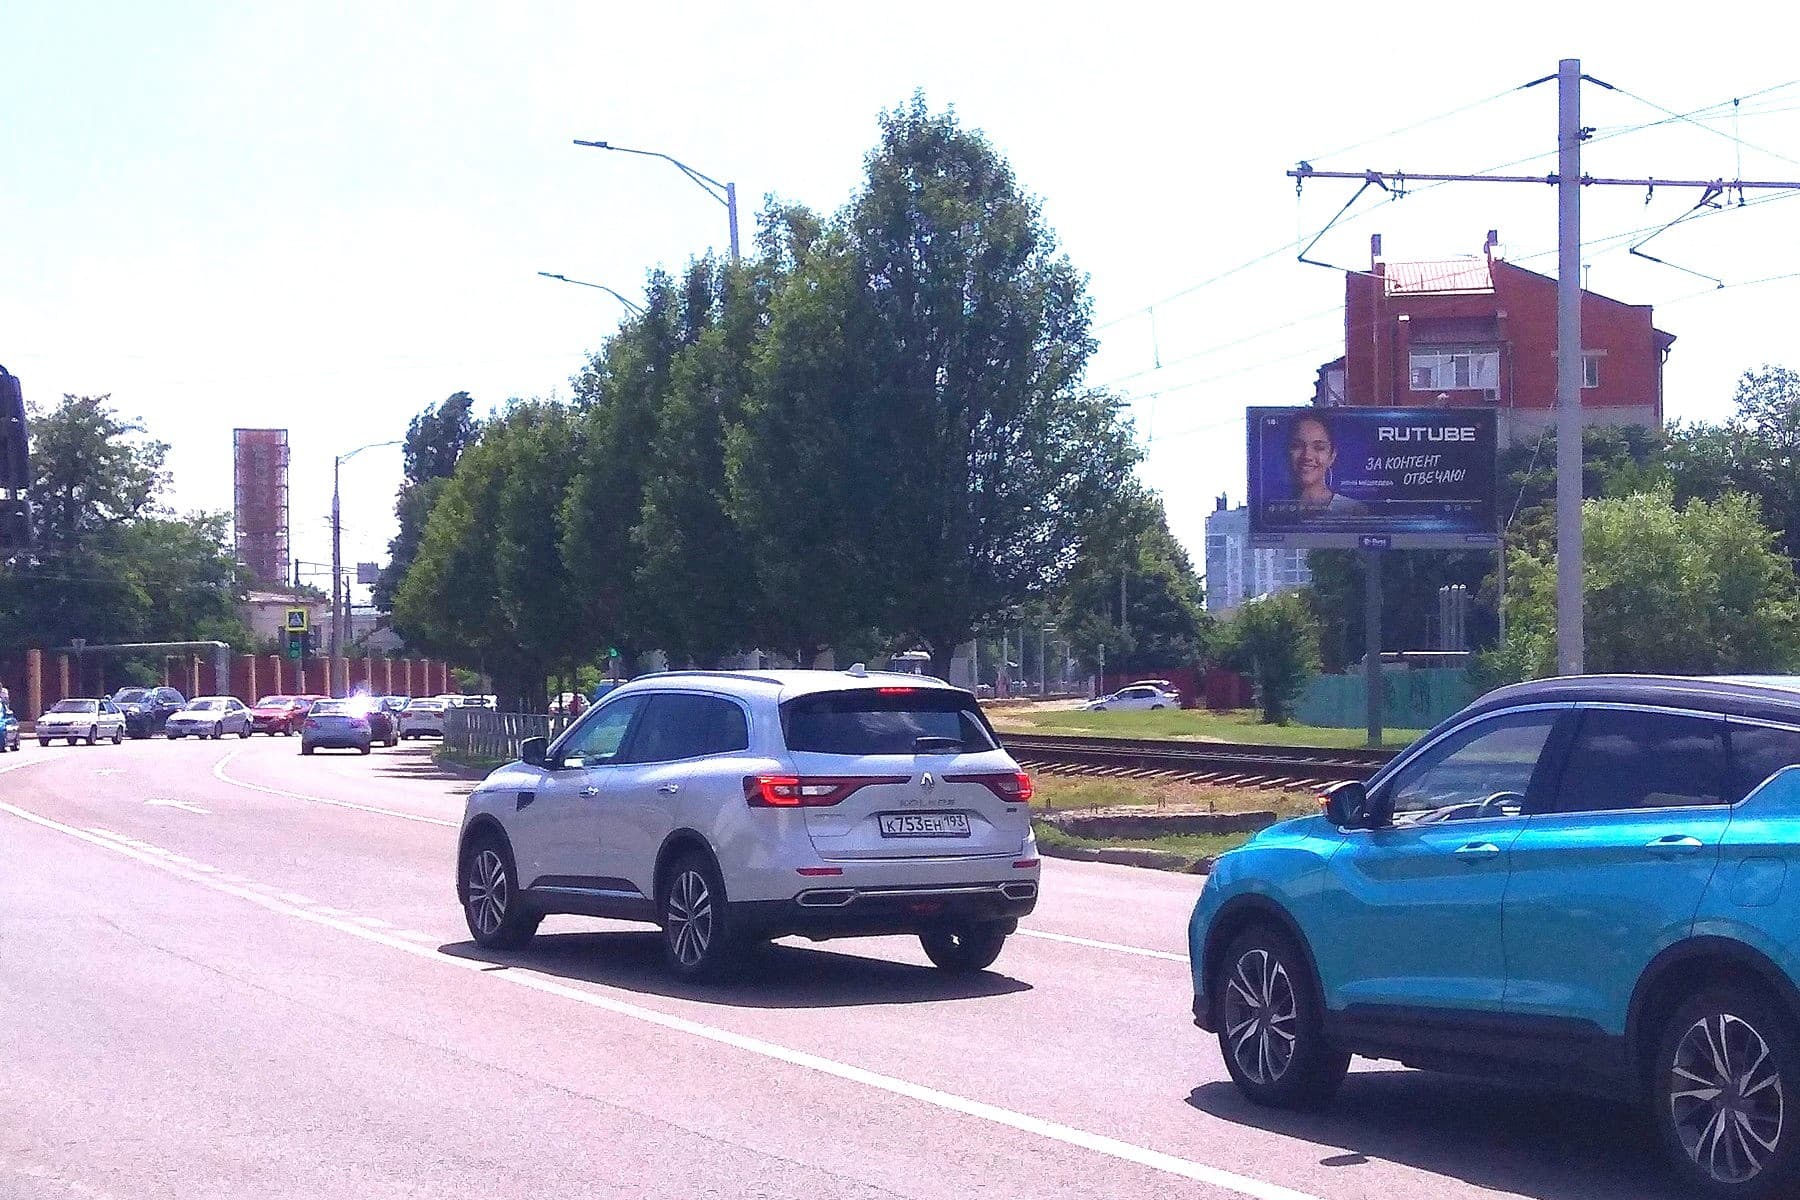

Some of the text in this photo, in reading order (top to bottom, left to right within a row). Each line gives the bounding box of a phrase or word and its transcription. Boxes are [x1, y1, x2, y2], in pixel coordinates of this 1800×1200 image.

[1378, 426, 1476, 441] RUTUBE
[1365, 454, 1441, 471] ЗА КОНТЕНТ
[1403, 468, 1466, 485] ОТВЕЧАЮ!
